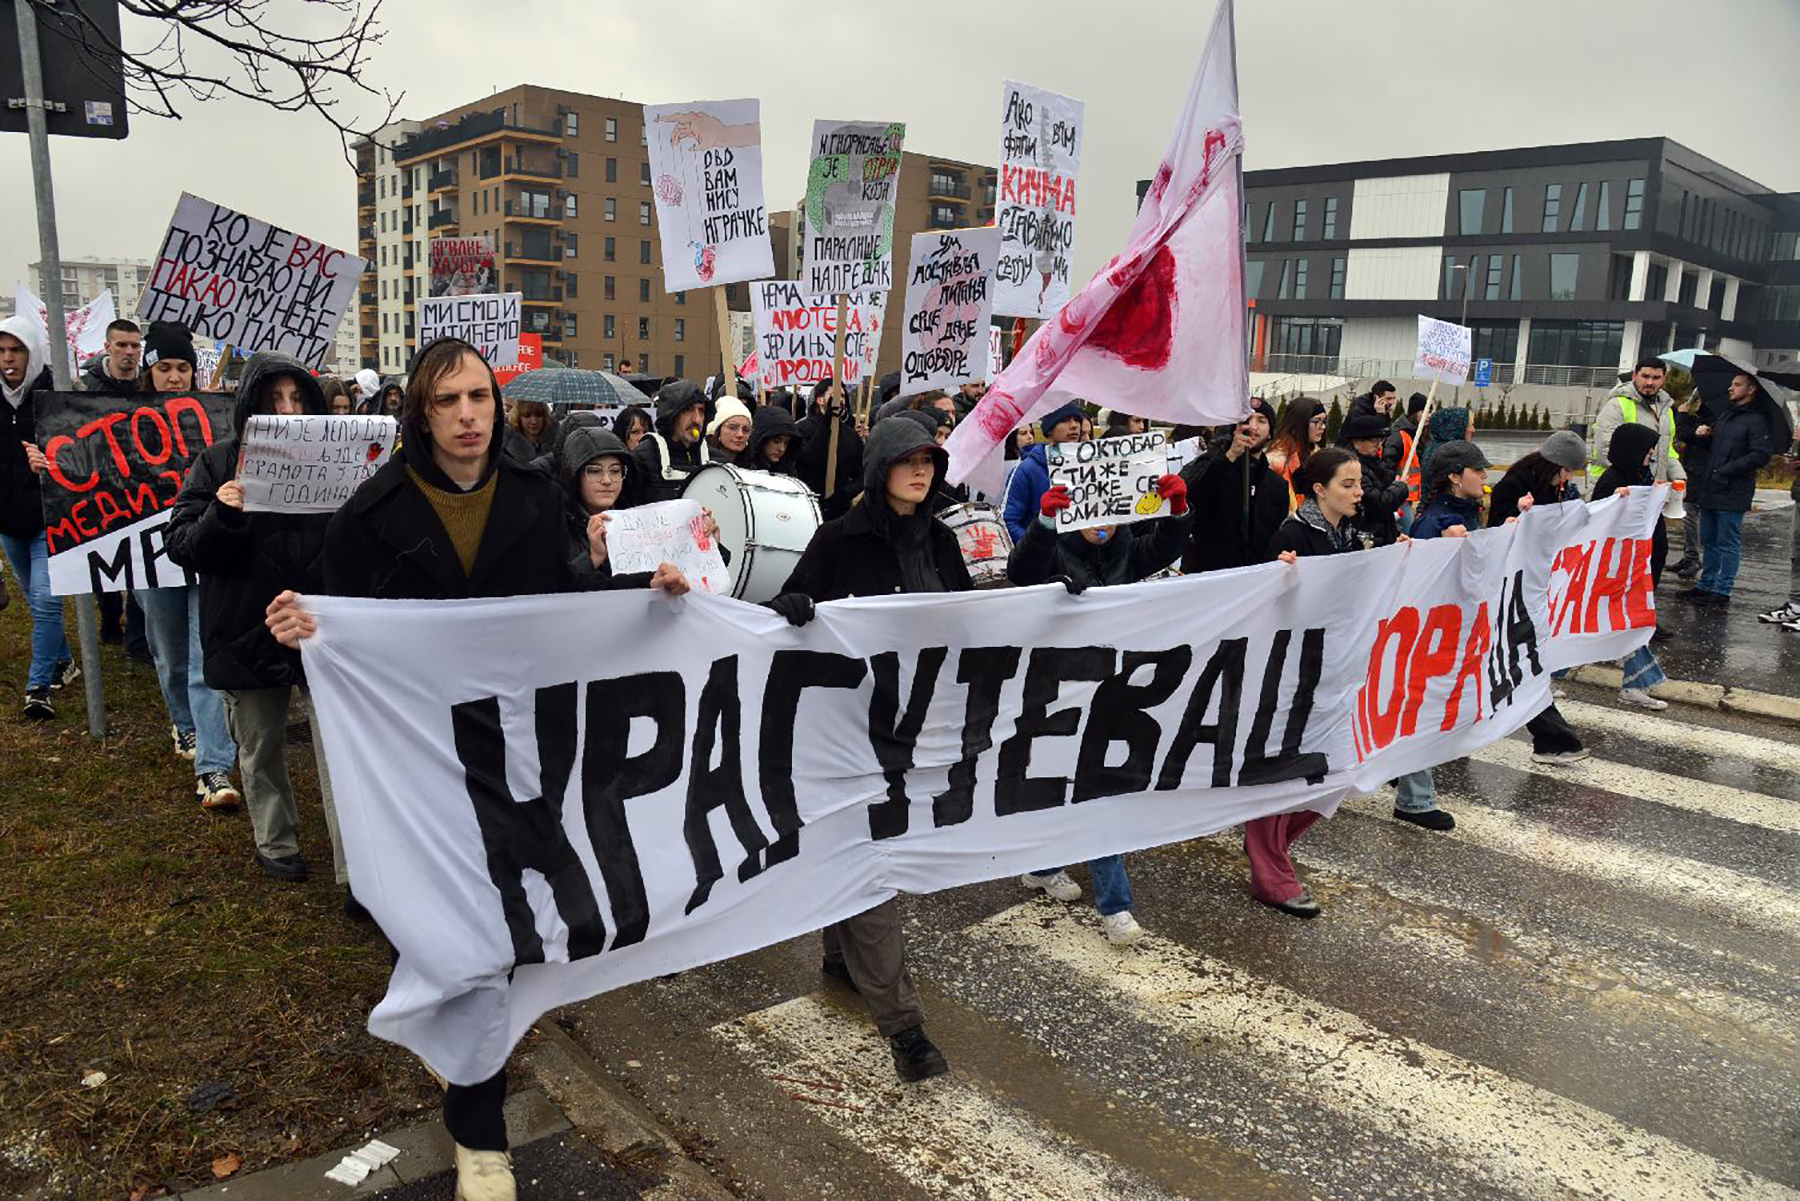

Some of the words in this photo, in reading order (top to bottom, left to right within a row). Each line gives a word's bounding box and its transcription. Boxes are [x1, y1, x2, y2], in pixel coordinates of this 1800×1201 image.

[704, 168, 738, 191] ВАМ
[823, 157, 839, 178] ЈЕ
[706, 188, 739, 211] НИСУ
[862, 182, 890, 201] КОЈИ
[1001, 163, 1075, 216] КИЧМА
[704, 206, 765, 245] ИГРАЧКЕ
[205, 205, 249, 246] КО
[250, 225, 292, 262] ЈЕ
[288, 235, 345, 279] ВАС
[814, 235, 882, 261] ПАРАЛИШЕ
[161, 226, 293, 294] ПОЗНАВАО
[292, 268, 335, 309] НИ
[812, 261, 890, 293] НАПРЕДАК
[151, 258, 236, 308] ПАКАО
[235, 284, 275, 318] МУ
[270, 294, 336, 338] НЕЋЕ
[762, 282, 806, 311] НЕМА
[939, 276, 987, 306] ПИТАЊА
[424, 302, 453, 325] МИ
[457, 300, 499, 322] СМО
[503, 298, 516, 320] И
[909, 308, 942, 335] СРЦЕ
[146, 286, 235, 340] ТЕШКО
[238, 317, 329, 370] ПАСТИ
[938, 318, 978, 346] ДАЈЕ
[763, 333, 785, 360] ЈЕР
[789, 333, 806, 358] И
[810, 333, 837, 358] ЊУ
[844, 331, 866, 358] СТЕ
[904, 347, 971, 384] ОДГОВОРЕ
[46, 397, 213, 492] СТОП
[362, 419, 388, 441] ДА
[1076, 433, 1165, 464] ОКТОБАР
[244, 459, 328, 481] СРАМОТА
[336, 467, 345, 481] У
[1050, 460, 1130, 487] СТИЖЕ
[1067, 479, 1122, 505] ОРКЕ
[1136, 475, 1160, 494] СЕ
[46, 467, 190, 554] МЕДИЈ
[1060, 495, 1134, 525] БЛИЖЕ
[451, 627, 1329, 984] КРАГУЈЕВАЦ
